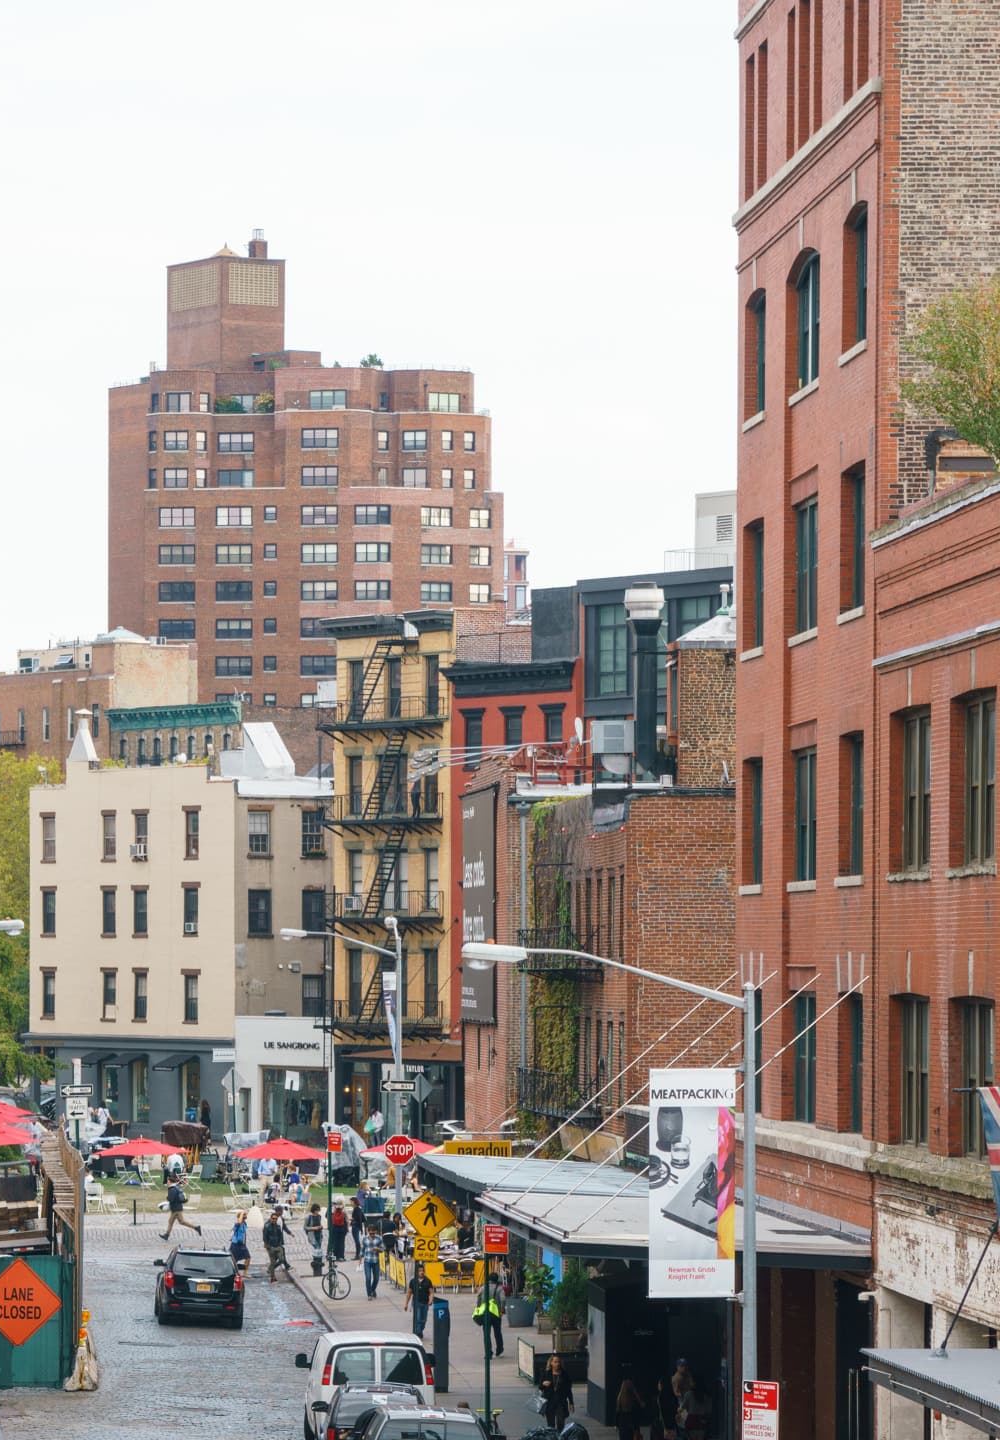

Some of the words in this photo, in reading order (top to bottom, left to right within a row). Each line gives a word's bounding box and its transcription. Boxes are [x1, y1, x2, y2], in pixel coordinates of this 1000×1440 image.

[276, 1041, 320, 1050] SANGBONG
[651, 1088, 734, 1101] MEATPACKING
[386, 1144, 413, 1156] STOP
[416, 1239, 437, 1251] 20
[4, 1288, 34, 1301] LANE
[744, 1408, 751, 1420] 3
